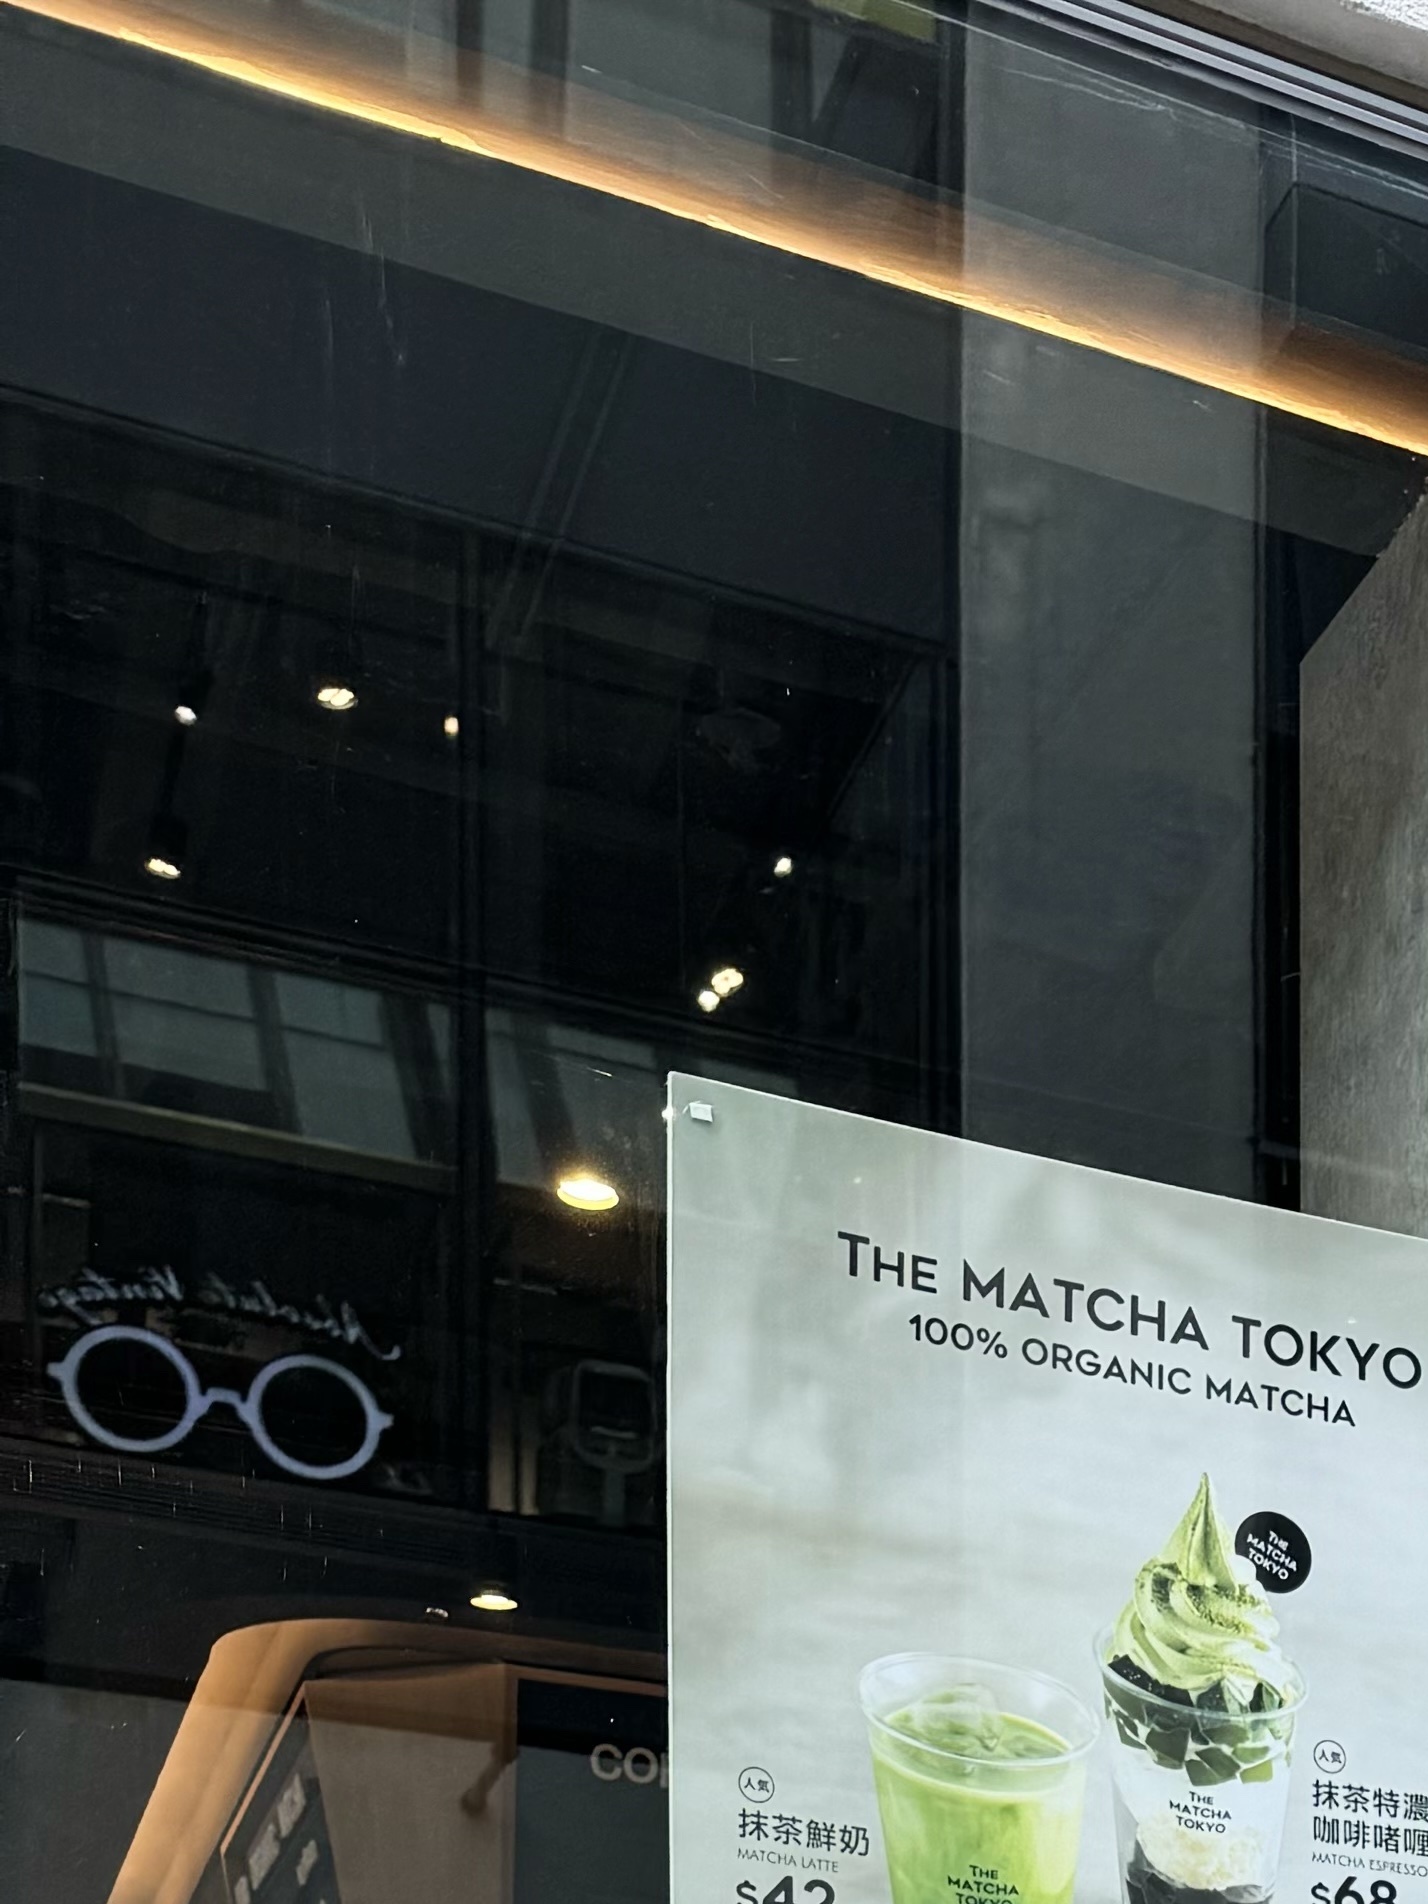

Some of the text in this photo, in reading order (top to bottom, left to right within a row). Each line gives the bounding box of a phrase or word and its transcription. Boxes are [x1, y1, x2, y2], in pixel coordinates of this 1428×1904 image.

[837, 1231, 1422, 1389] THE MATCHA TOKYO
[908, 1314, 1356, 1427] 100% ORGANIC MATCHA
[1269, 1530, 1289, 1551] THE
[1247, 1533, 1297, 1572] MATCHA
[1249, 1547, 1289, 1580] TOKYO
[1318, 1749, 1342, 1764] 人氣
[744, 1777, 770, 1794] 人氣
[1188, 1791, 1214, 1806] THE
[1169, 1800, 1232, 1821] MATCHA
[738, 1808, 870, 1857] 抹茶鮮奶
[1176, 1816, 1227, 1834] TOKYO
[738, 1848, 839, 1873] MATCHA LATTE
[1312, 1852, 1365, 1869] MATCHA
[1369, 1859, 1428, 1878] ESPRESSO
[969, 1865, 999, 1881] THE
[947, 1875, 1020, 1896] MATCHA
